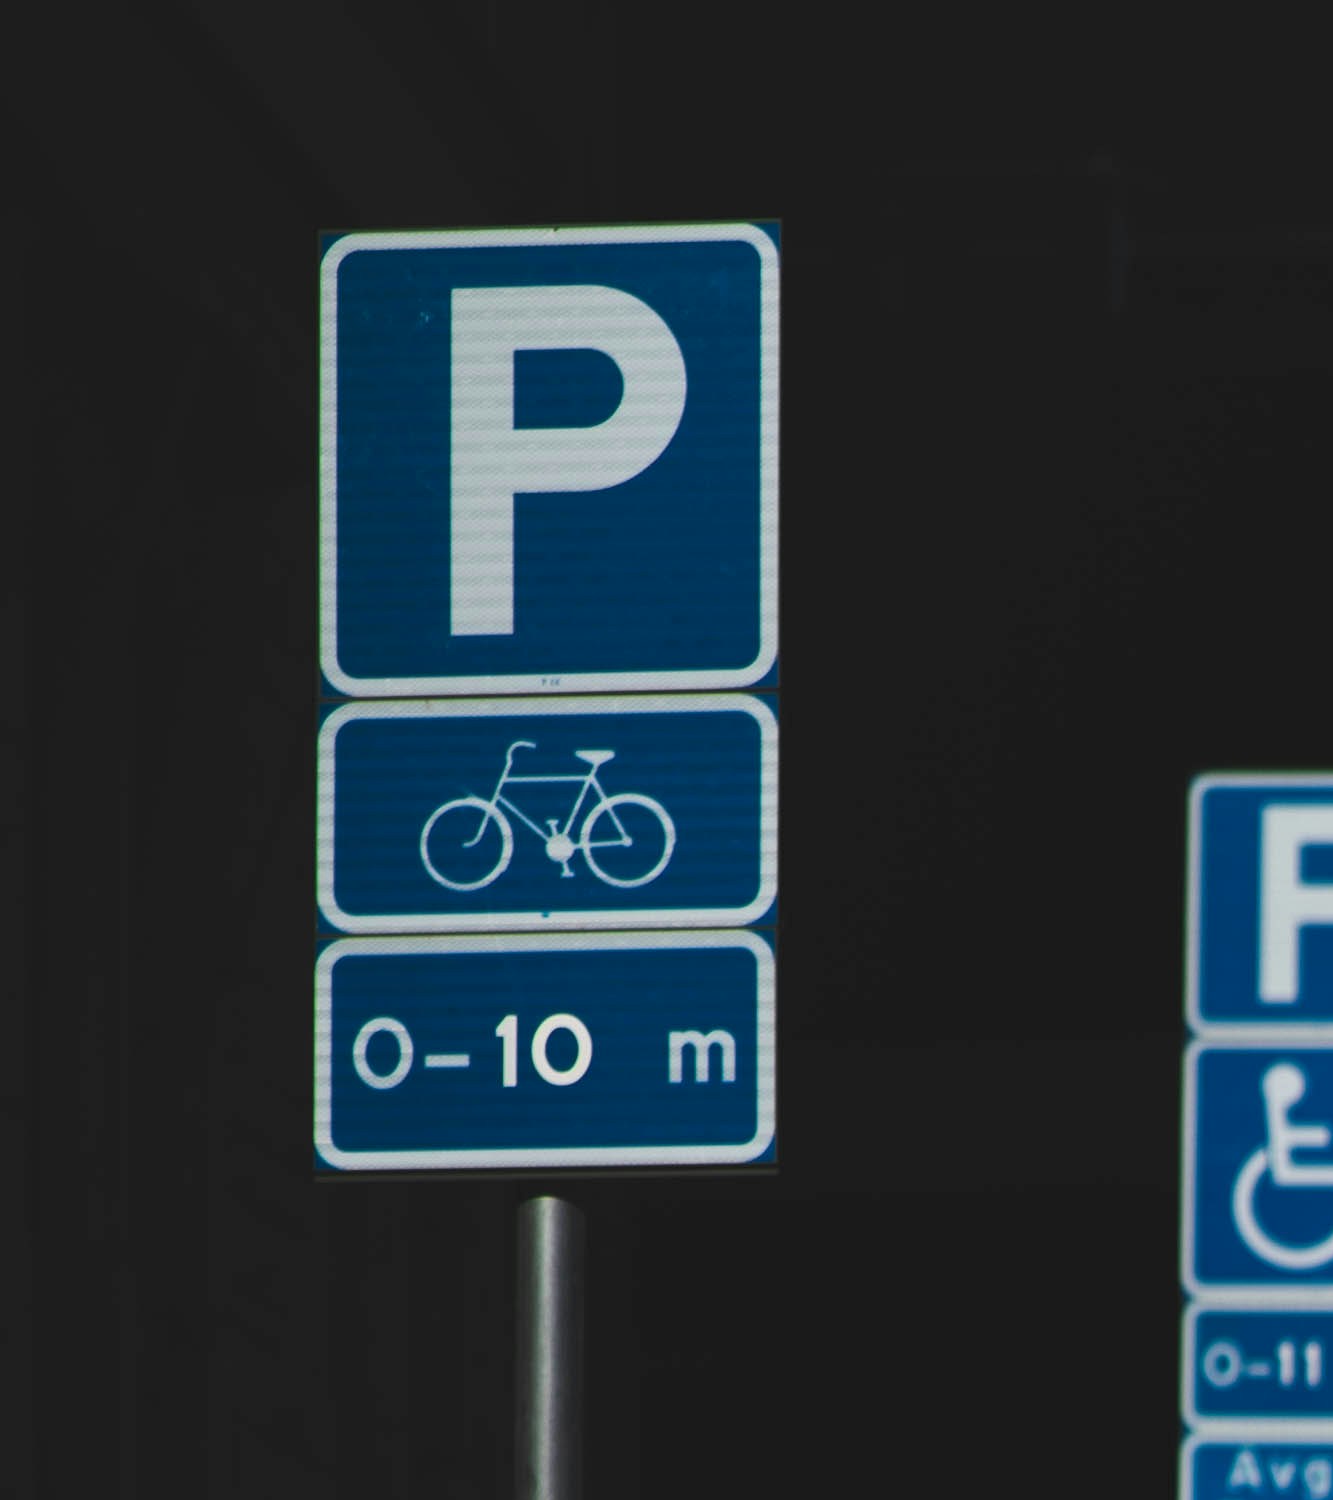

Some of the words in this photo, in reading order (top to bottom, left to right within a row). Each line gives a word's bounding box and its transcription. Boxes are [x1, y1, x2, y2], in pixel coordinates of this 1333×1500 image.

[450, 284, 686, 636] P
[353, 1012, 593, 1090] 0-10
[668, 1028, 736, 1084] m
[1203, 1340, 1323, 1387] 0-11
